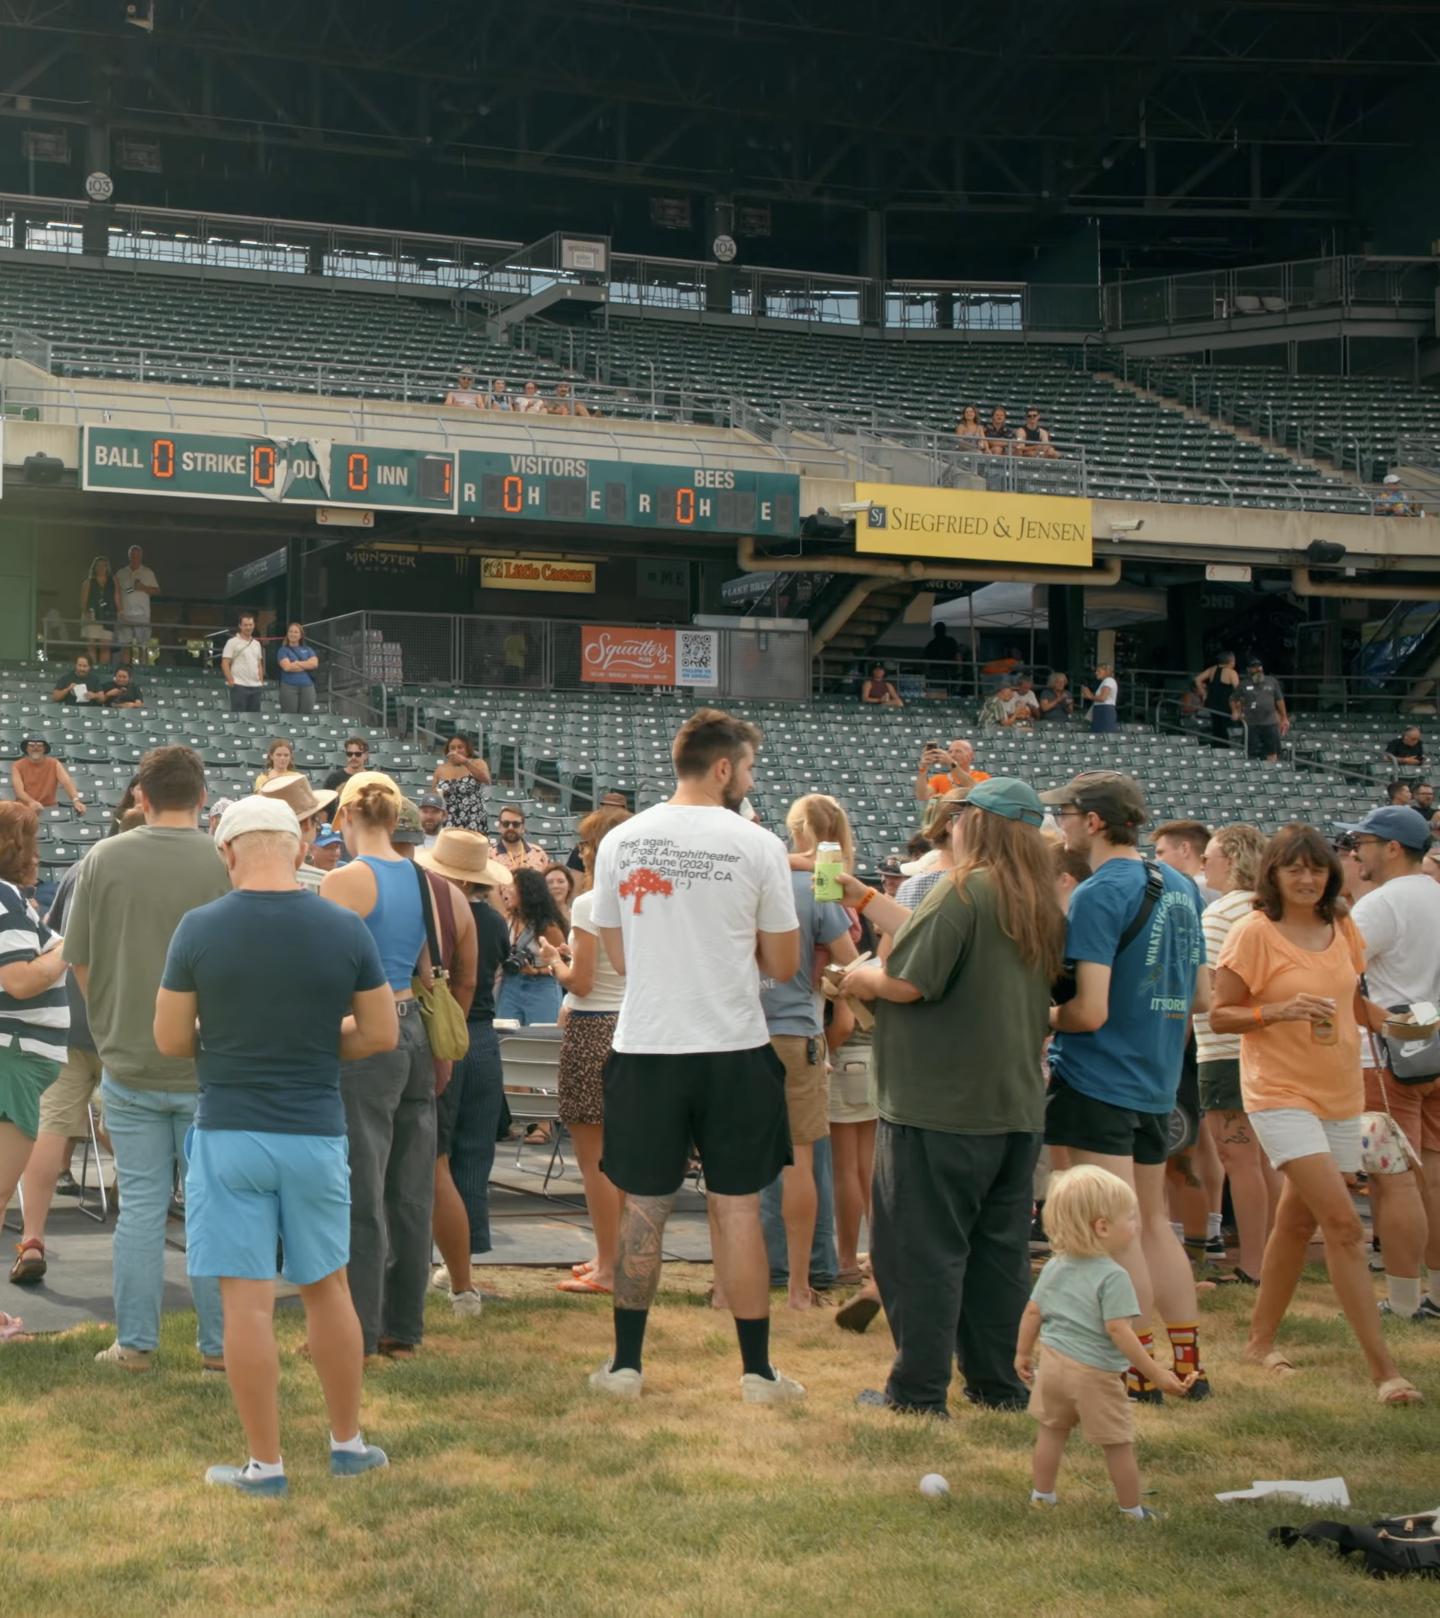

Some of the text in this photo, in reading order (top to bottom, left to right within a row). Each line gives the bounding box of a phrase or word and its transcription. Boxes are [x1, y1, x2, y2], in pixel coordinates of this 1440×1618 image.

[88, 180, 111, 193] 103
[714, 242, 734, 255] 104
[94, 445, 144, 469] BALL
[152, 439, 175, 478] 0
[181, 451, 247, 476] STRIKE
[253, 446, 276, 485] 0
[292, 458, 322, 480] OU
[347, 453, 369, 491] 0
[377, 464, 409, 487] INN
[510, 455, 588, 478] VISITORS
[693, 469, 736, 490] BEES
[463, 475, 602, 513] R 0 H E
[638, 488, 772, 524] R 0 H E
[319, 509, 329, 523] 5
[362, 512, 372, 526] 6
[891, 507, 989, 536] SIEGFRIED
[992, 515, 1013, 538] &
[1016, 516, 1087, 542] JENSEN
[504, 562, 593, 583] Little Caesars
[660, 570, 686, 587] ME
[1240, 567, 1250, 580] 7
[585, 632, 673, 670] Squatters
[631, 847, 742, 863] Frost Amphitheater
[648, 856, 677, 867] June
[679, 859, 714, 873] (2024)
[660, 866, 734, 882] Stanford, CA
